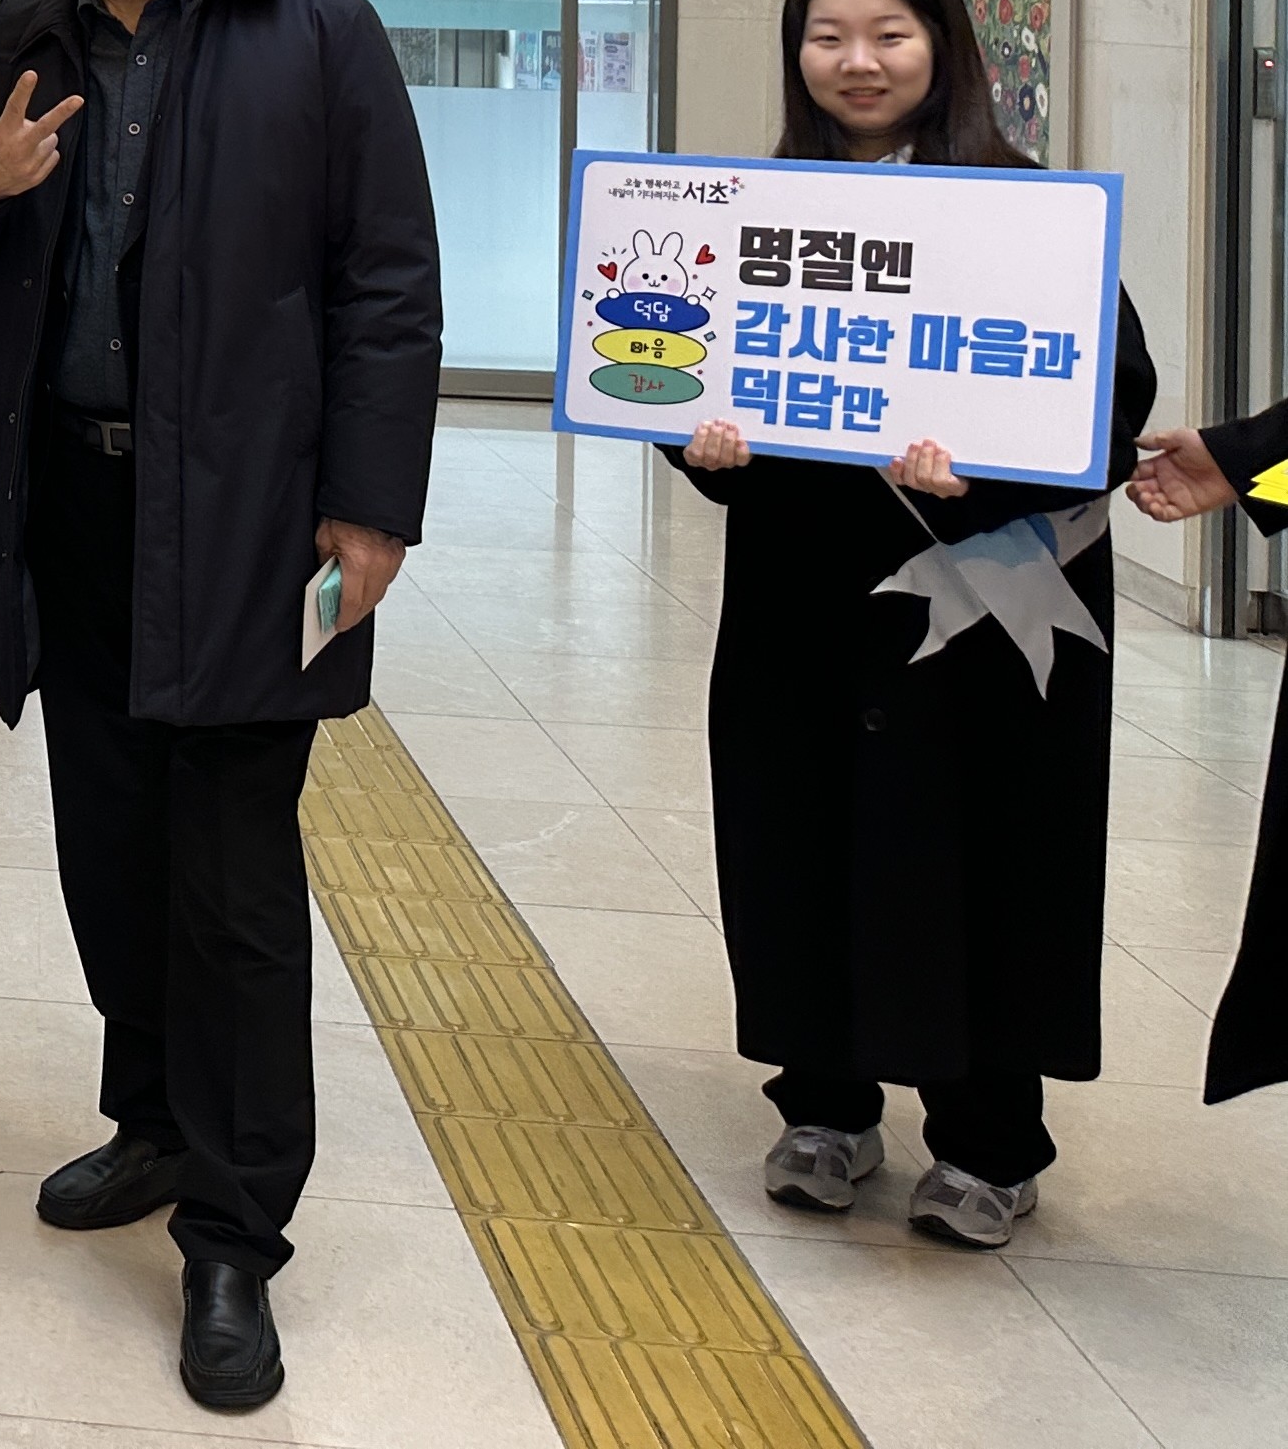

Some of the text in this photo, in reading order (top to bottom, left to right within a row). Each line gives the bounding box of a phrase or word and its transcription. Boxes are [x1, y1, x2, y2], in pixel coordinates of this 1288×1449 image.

[624, 178, 642, 188] 오늘
[682, 180, 730, 204] 서초
[738, 225, 914, 294] 명절엔
[633, 300, 672, 323] 덕담
[630, 338, 667, 359] 마음
[734, 299, 1081, 380] 감사한 마음과
[628, 373, 665, 393] 감사
[730, 367, 889, 433] 덕담만
